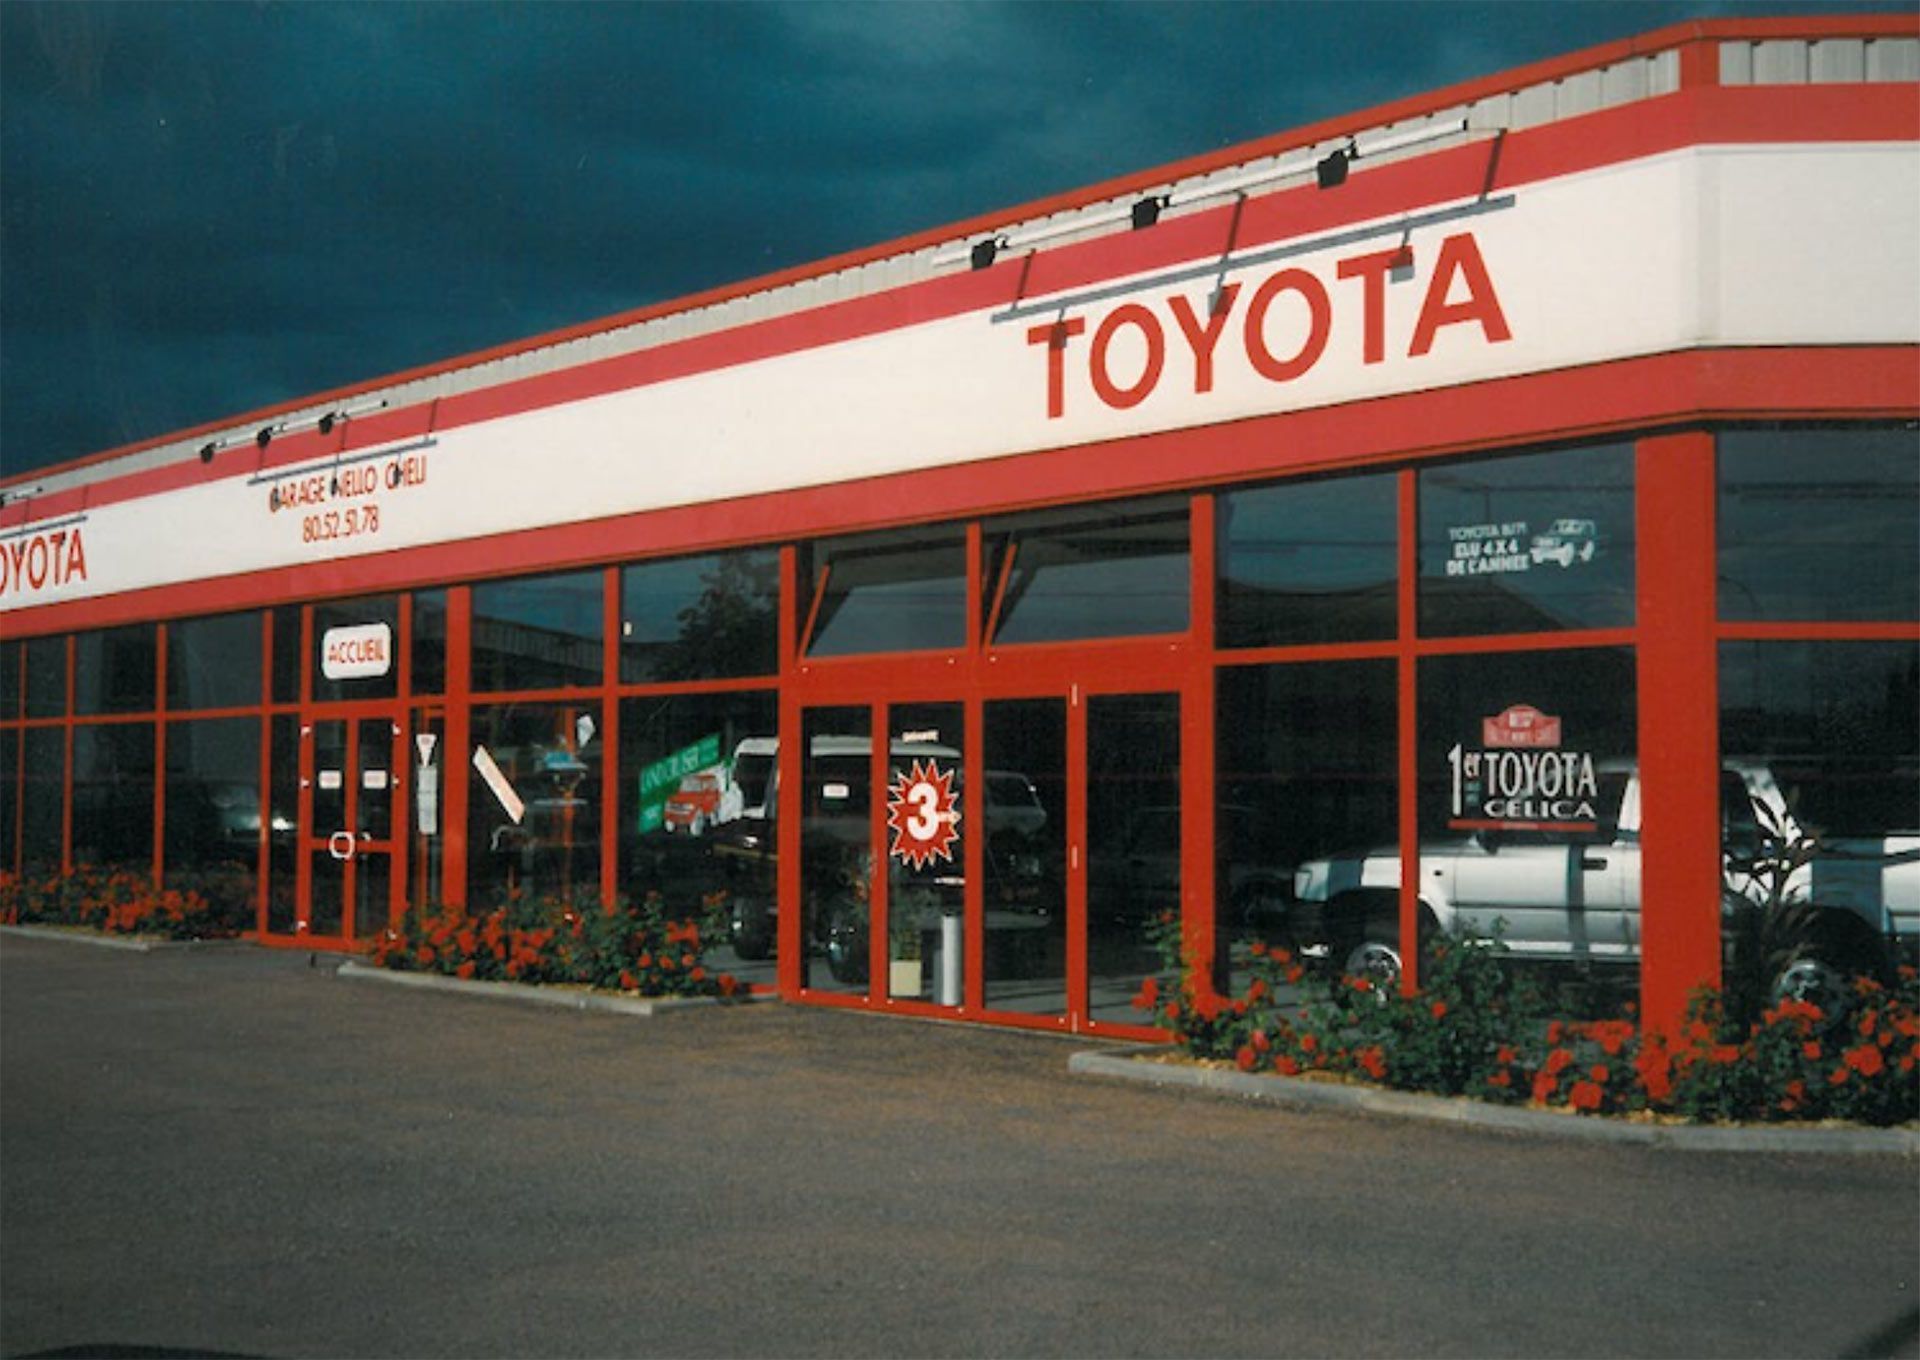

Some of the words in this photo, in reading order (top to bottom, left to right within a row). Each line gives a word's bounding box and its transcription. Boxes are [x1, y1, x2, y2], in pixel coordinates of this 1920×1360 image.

[1027, 231, 1512, 419] TOYOTA
[269, 475, 326, 513] GARAGE
[328, 638, 384, 664] ACCUEIL
[1483, 751, 1598, 797] TOYOTA
[906, 781, 940, 842] 3
[1483, 800, 1597, 819] CELICA
